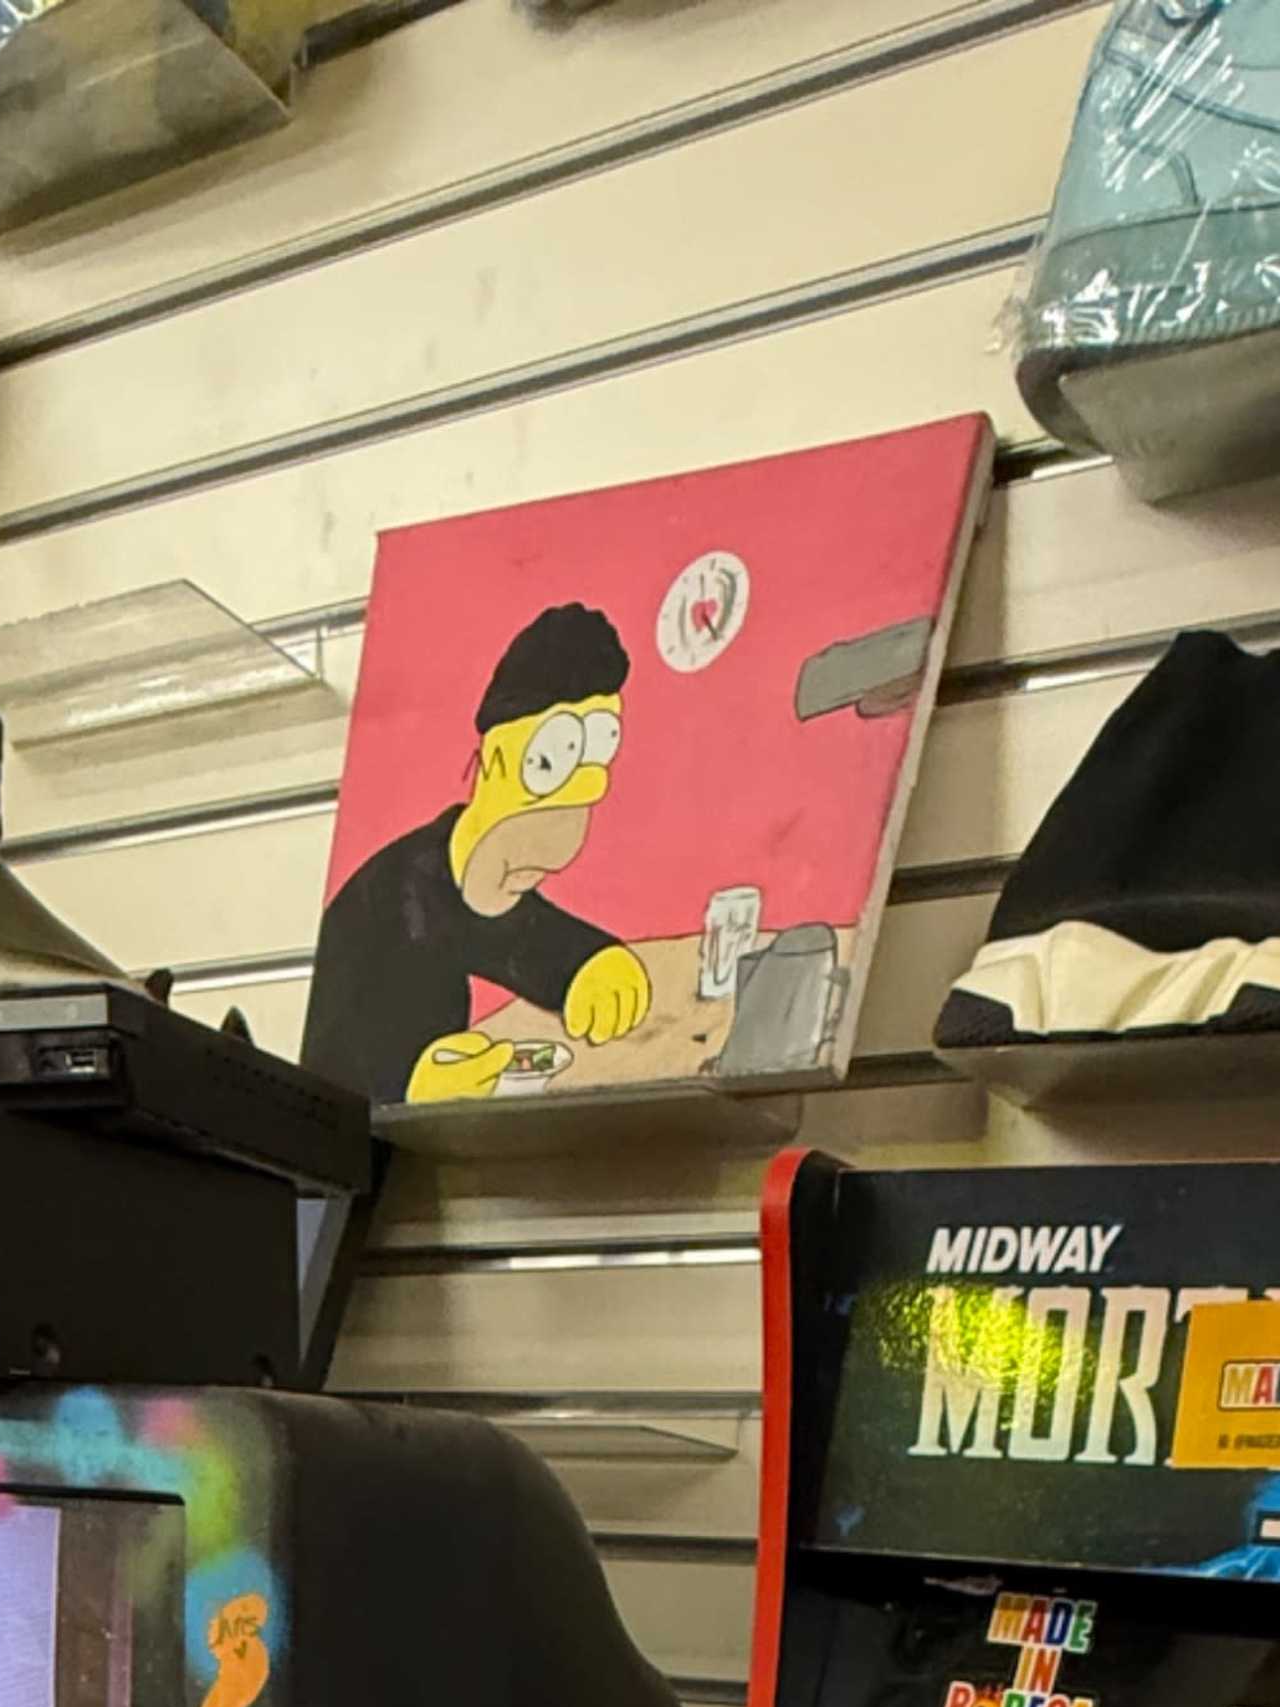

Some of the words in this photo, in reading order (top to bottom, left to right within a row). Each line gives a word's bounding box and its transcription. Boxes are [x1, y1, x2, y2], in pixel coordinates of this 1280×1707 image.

[926, 1223, 1123, 1275] MIDWAY
[986, 1591, 1097, 1653] MADE
[1012, 1646, 1063, 1695] IN
